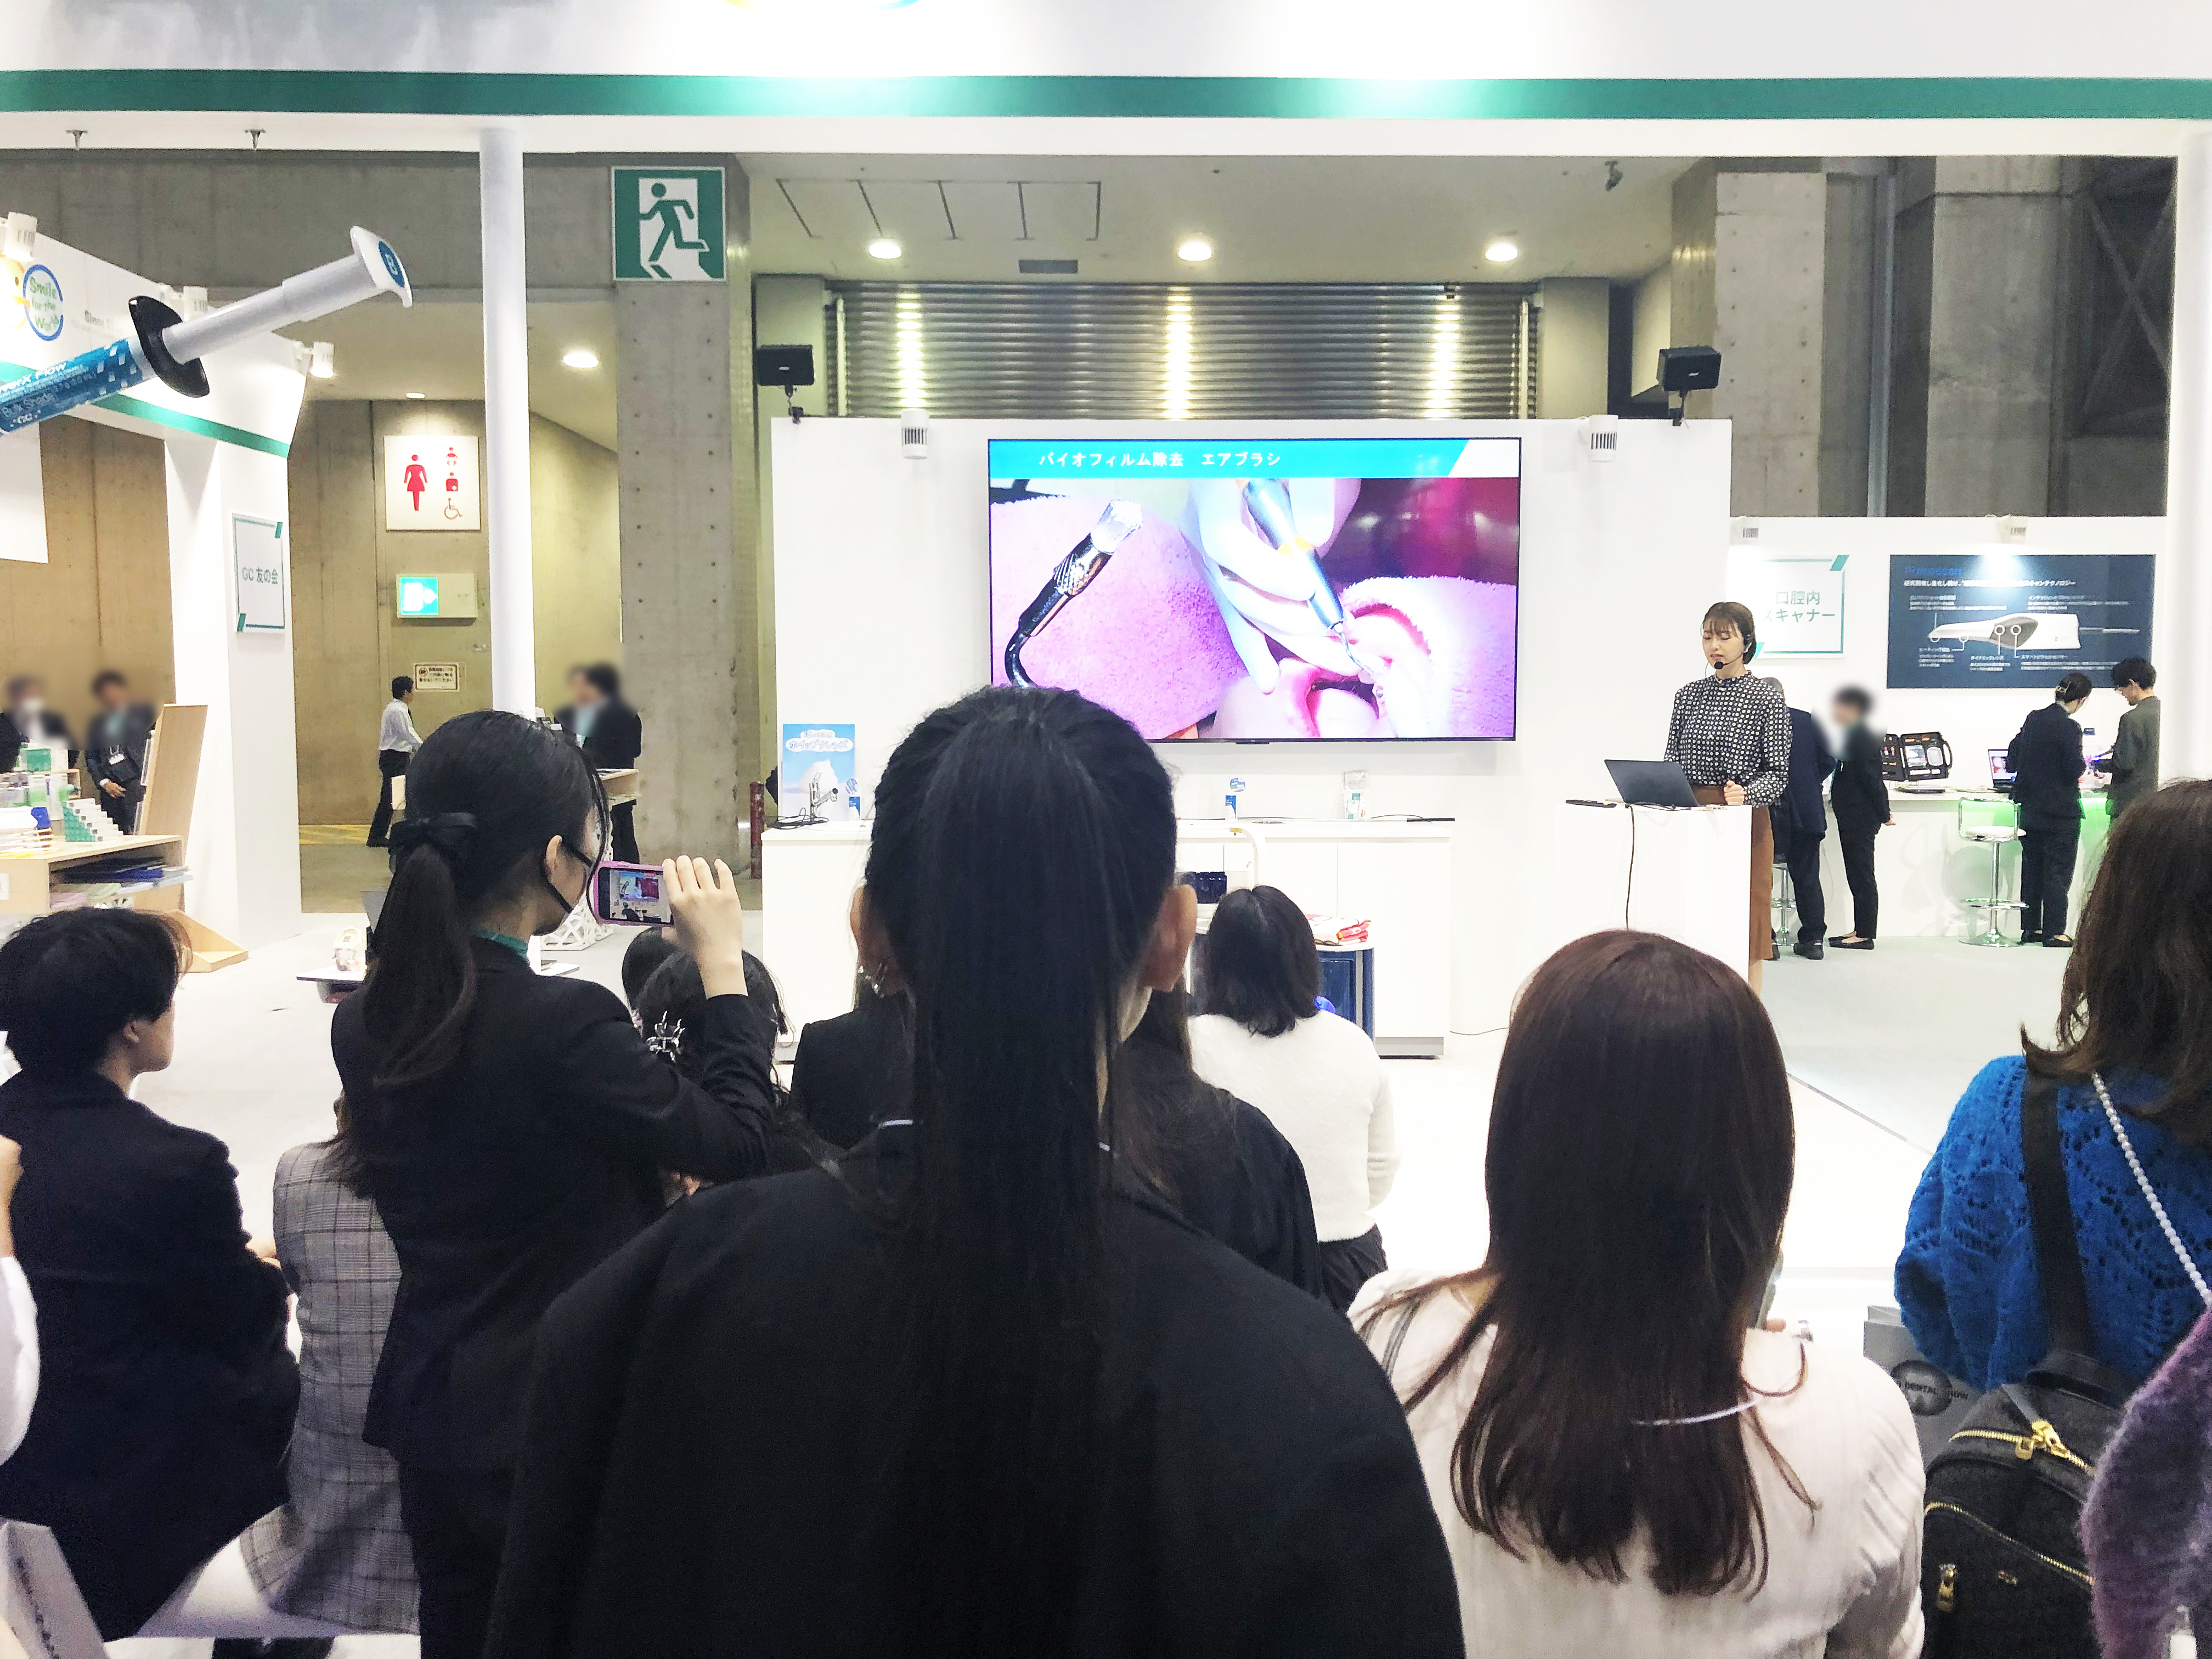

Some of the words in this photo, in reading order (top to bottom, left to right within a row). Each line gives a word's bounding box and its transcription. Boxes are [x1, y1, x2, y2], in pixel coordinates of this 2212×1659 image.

[29, 276, 57, 300] Smile
[1039, 452, 1184, 467] バイオフィルム除去
[1201, 452, 1281, 467] エアブラシ
[256, 566, 278, 585] 友の会
[1776, 590, 1820, 605] 口腔内
